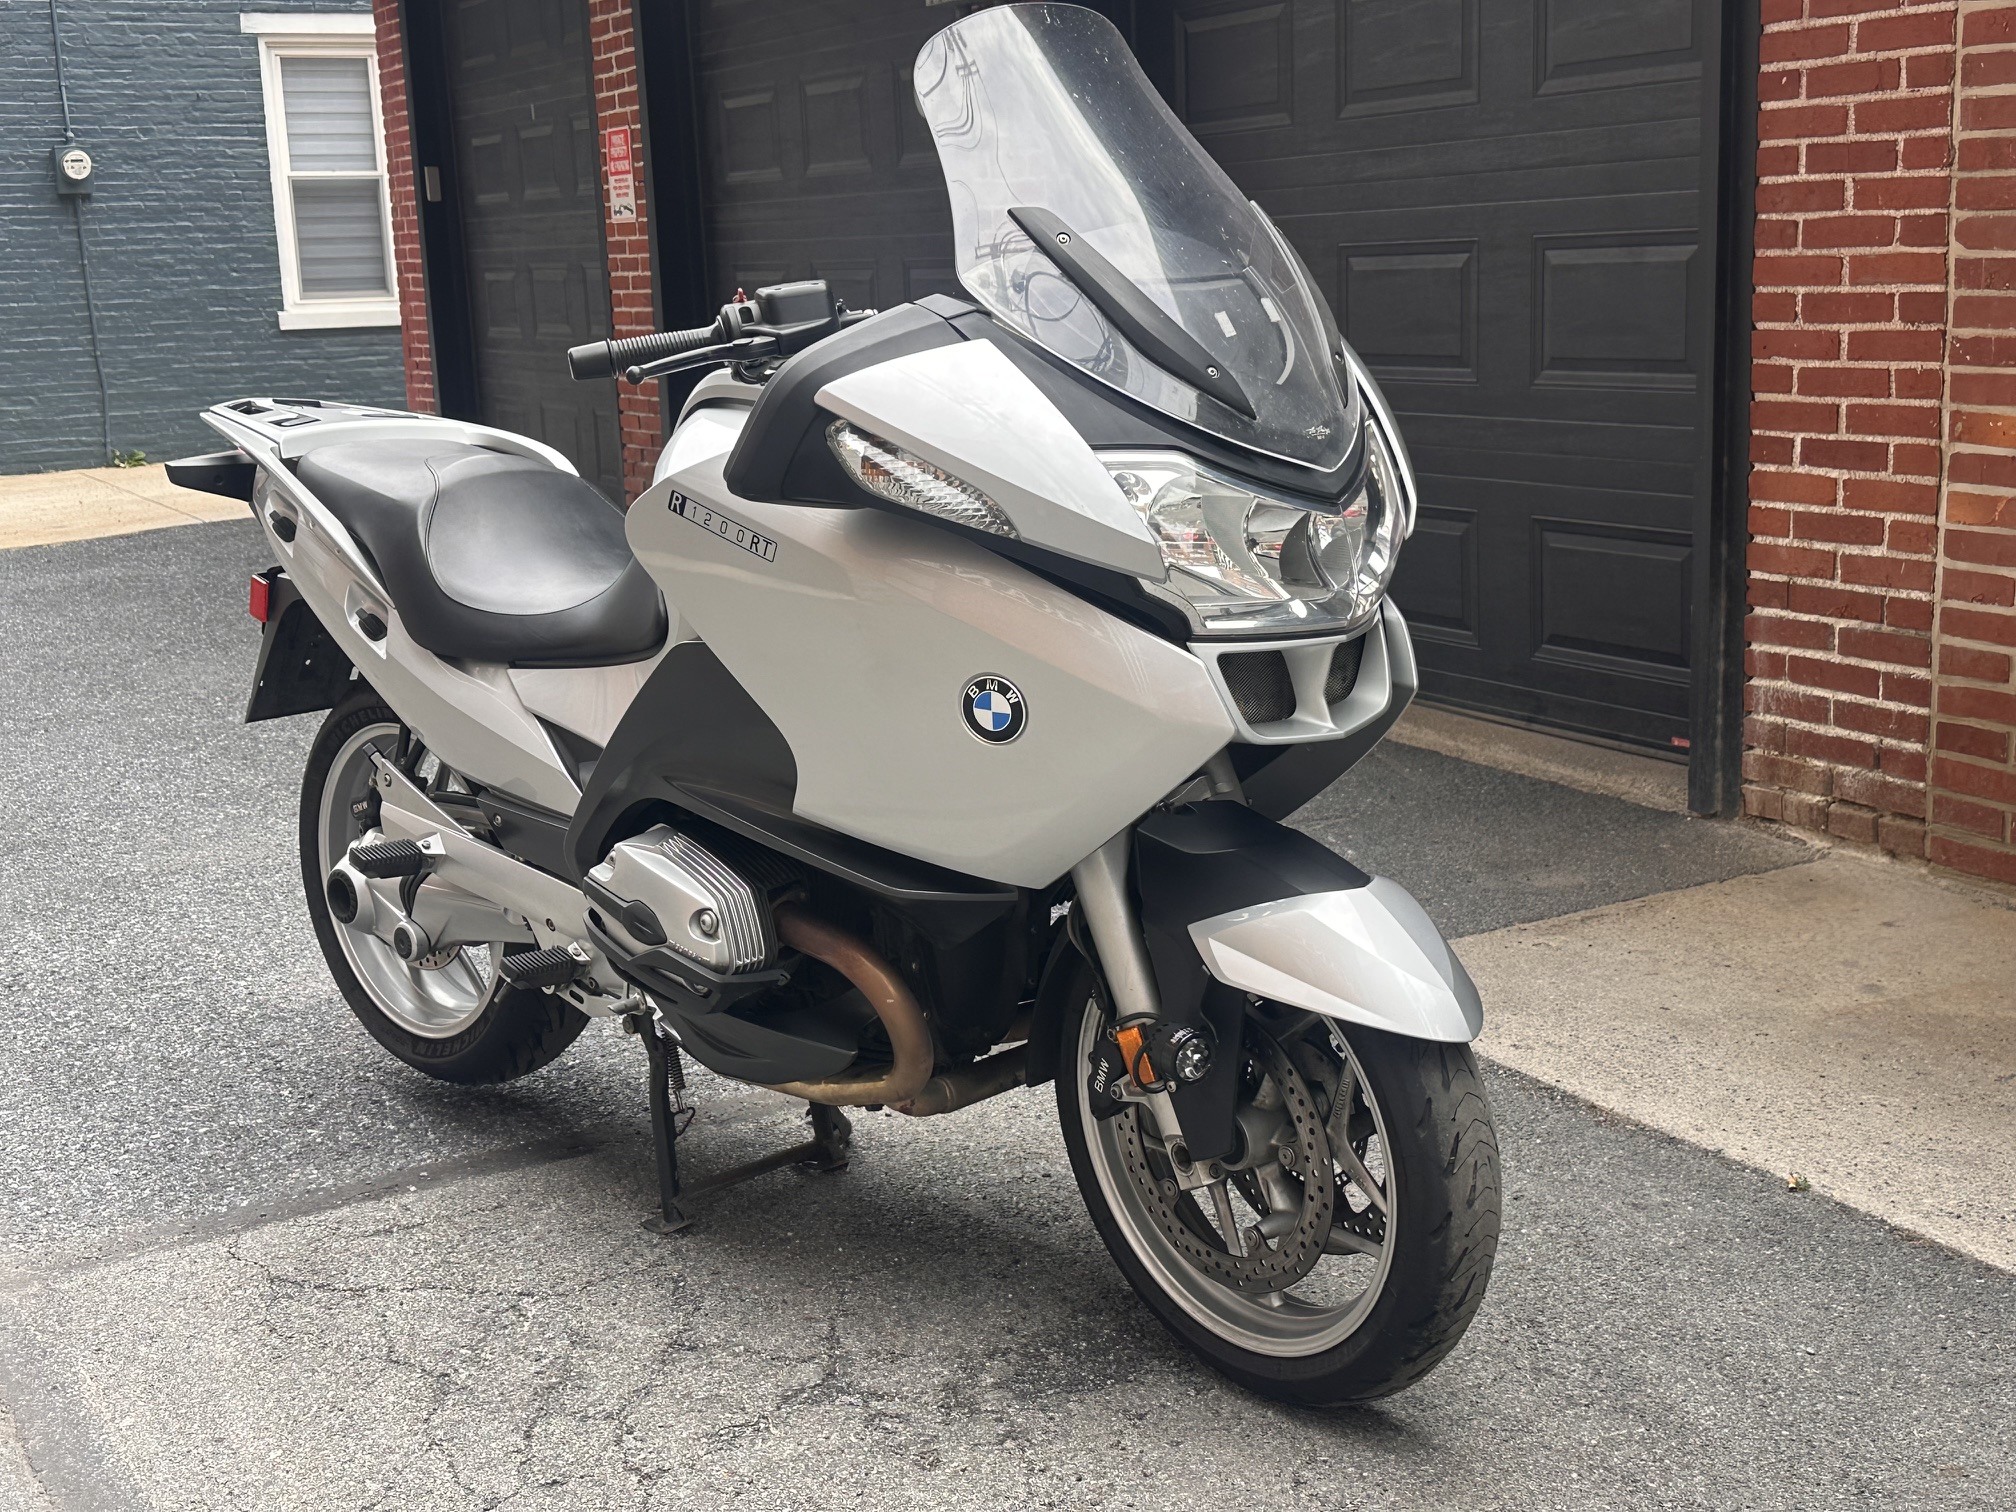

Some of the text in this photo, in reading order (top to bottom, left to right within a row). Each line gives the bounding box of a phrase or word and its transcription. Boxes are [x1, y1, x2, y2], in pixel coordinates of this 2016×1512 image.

[967, 679, 1019, 704] BMW
[352, 800, 368, 813] BMW
[1095, 1057, 1110, 1093] BMW
